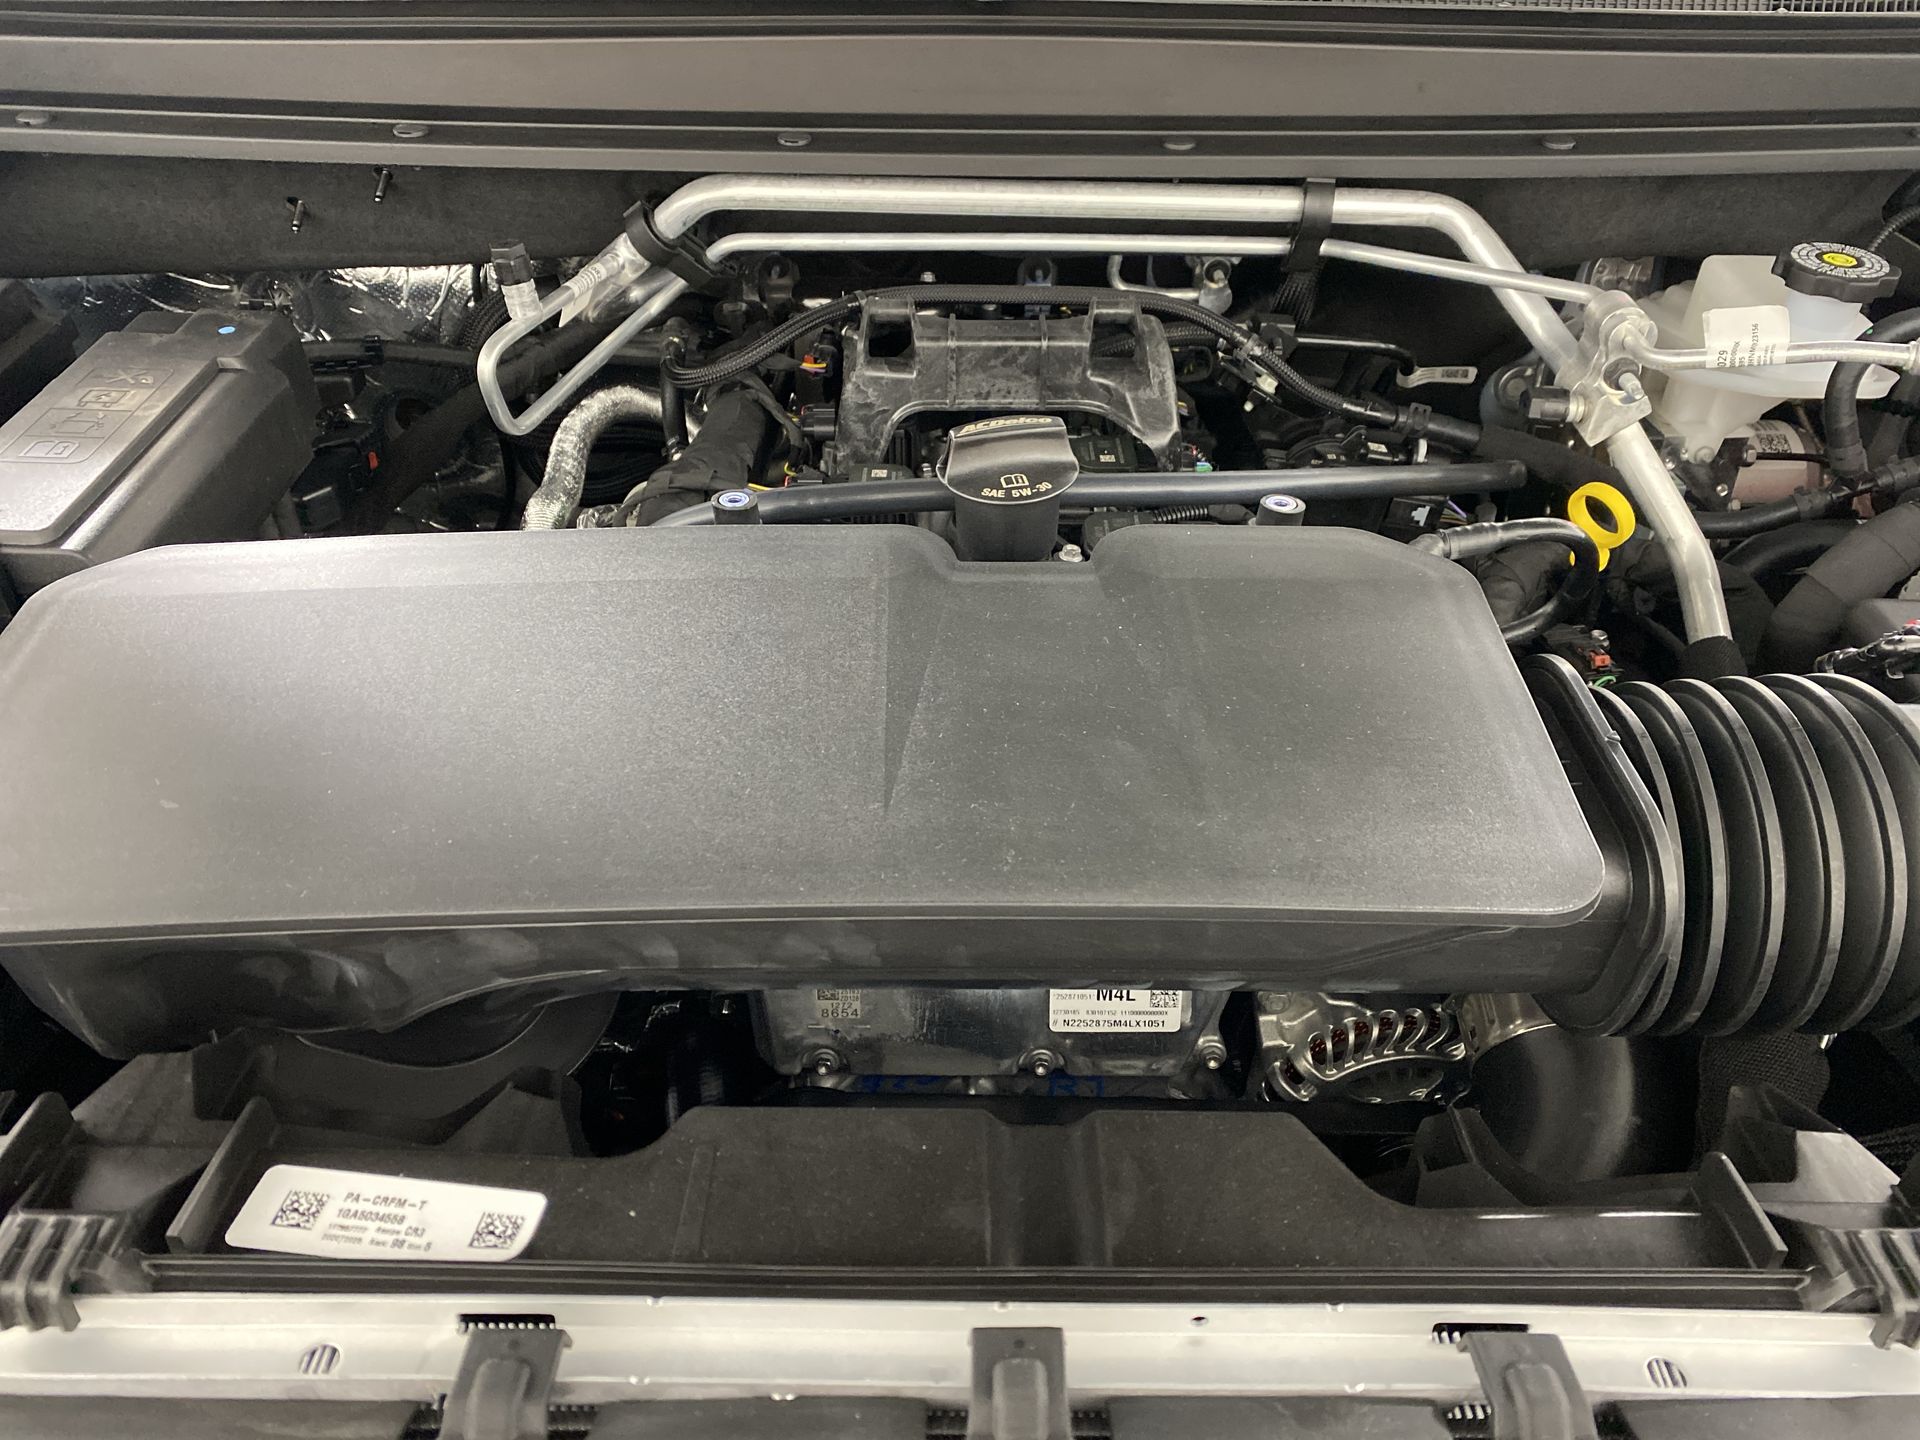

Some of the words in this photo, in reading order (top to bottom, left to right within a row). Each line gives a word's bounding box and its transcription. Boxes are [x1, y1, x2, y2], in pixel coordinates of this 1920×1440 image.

[956, 417, 1052, 436] ACDelco
[981, 487, 1006, 498] SAE
[1011, 481, 1053, 498] 5W-30
[1096, 989, 1136, 1002] M4L
[821, 1008, 860, 1018] 8654
[1063, 1019, 1165, 1028] N2252875M4LX1051
